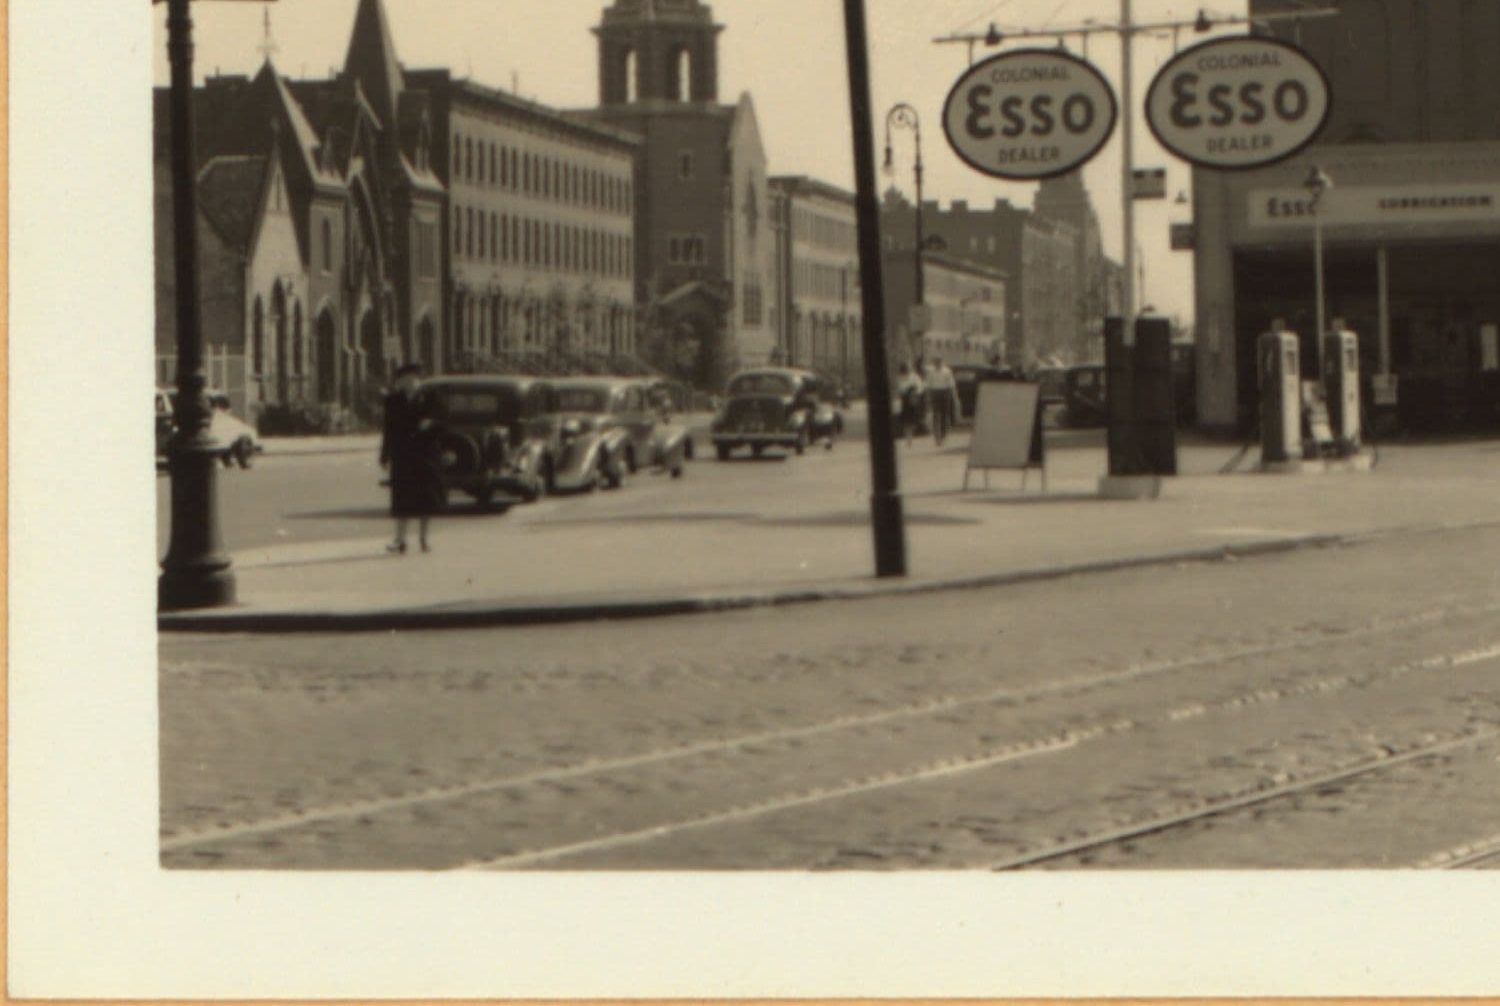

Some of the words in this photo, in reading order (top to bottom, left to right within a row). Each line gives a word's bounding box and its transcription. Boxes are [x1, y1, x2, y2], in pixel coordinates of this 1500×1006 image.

[1196, 51, 1283, 71] COLONIAL
[991, 66, 1071, 84] COLONIAL
[1206, 135, 1274, 154] DEALER
[998, 146, 1062, 164] DEALER
